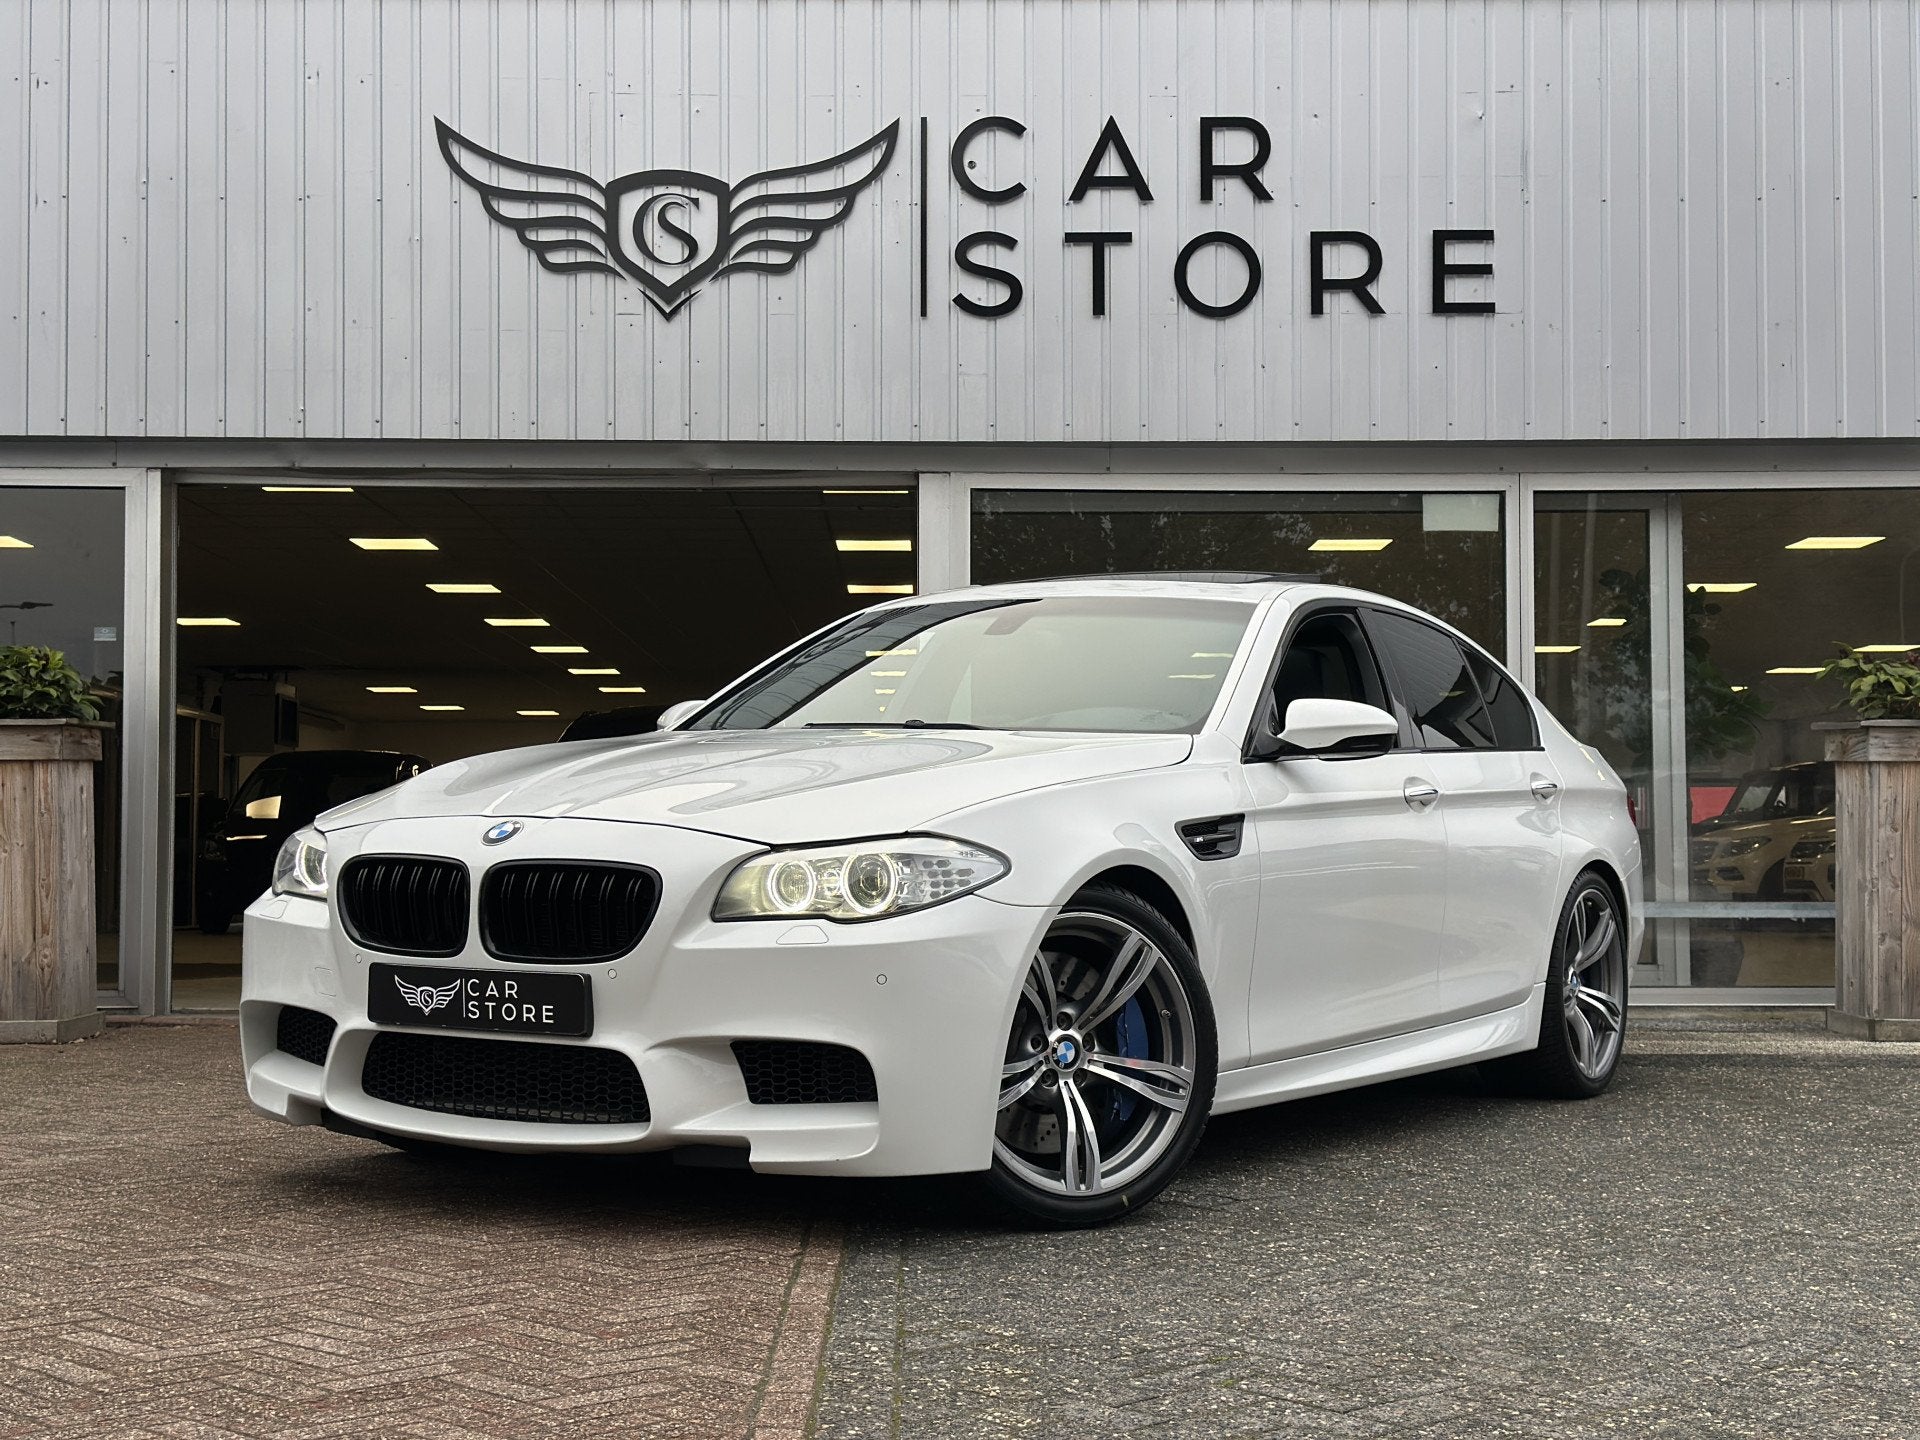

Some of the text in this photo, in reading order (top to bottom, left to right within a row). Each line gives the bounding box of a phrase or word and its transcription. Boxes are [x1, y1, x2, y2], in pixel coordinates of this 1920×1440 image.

[951, 116, 1274, 203] CAR
[952, 230, 1496, 319] STORE
[467, 978, 518, 999] CAR
[467, 1000, 555, 1024] STORE
